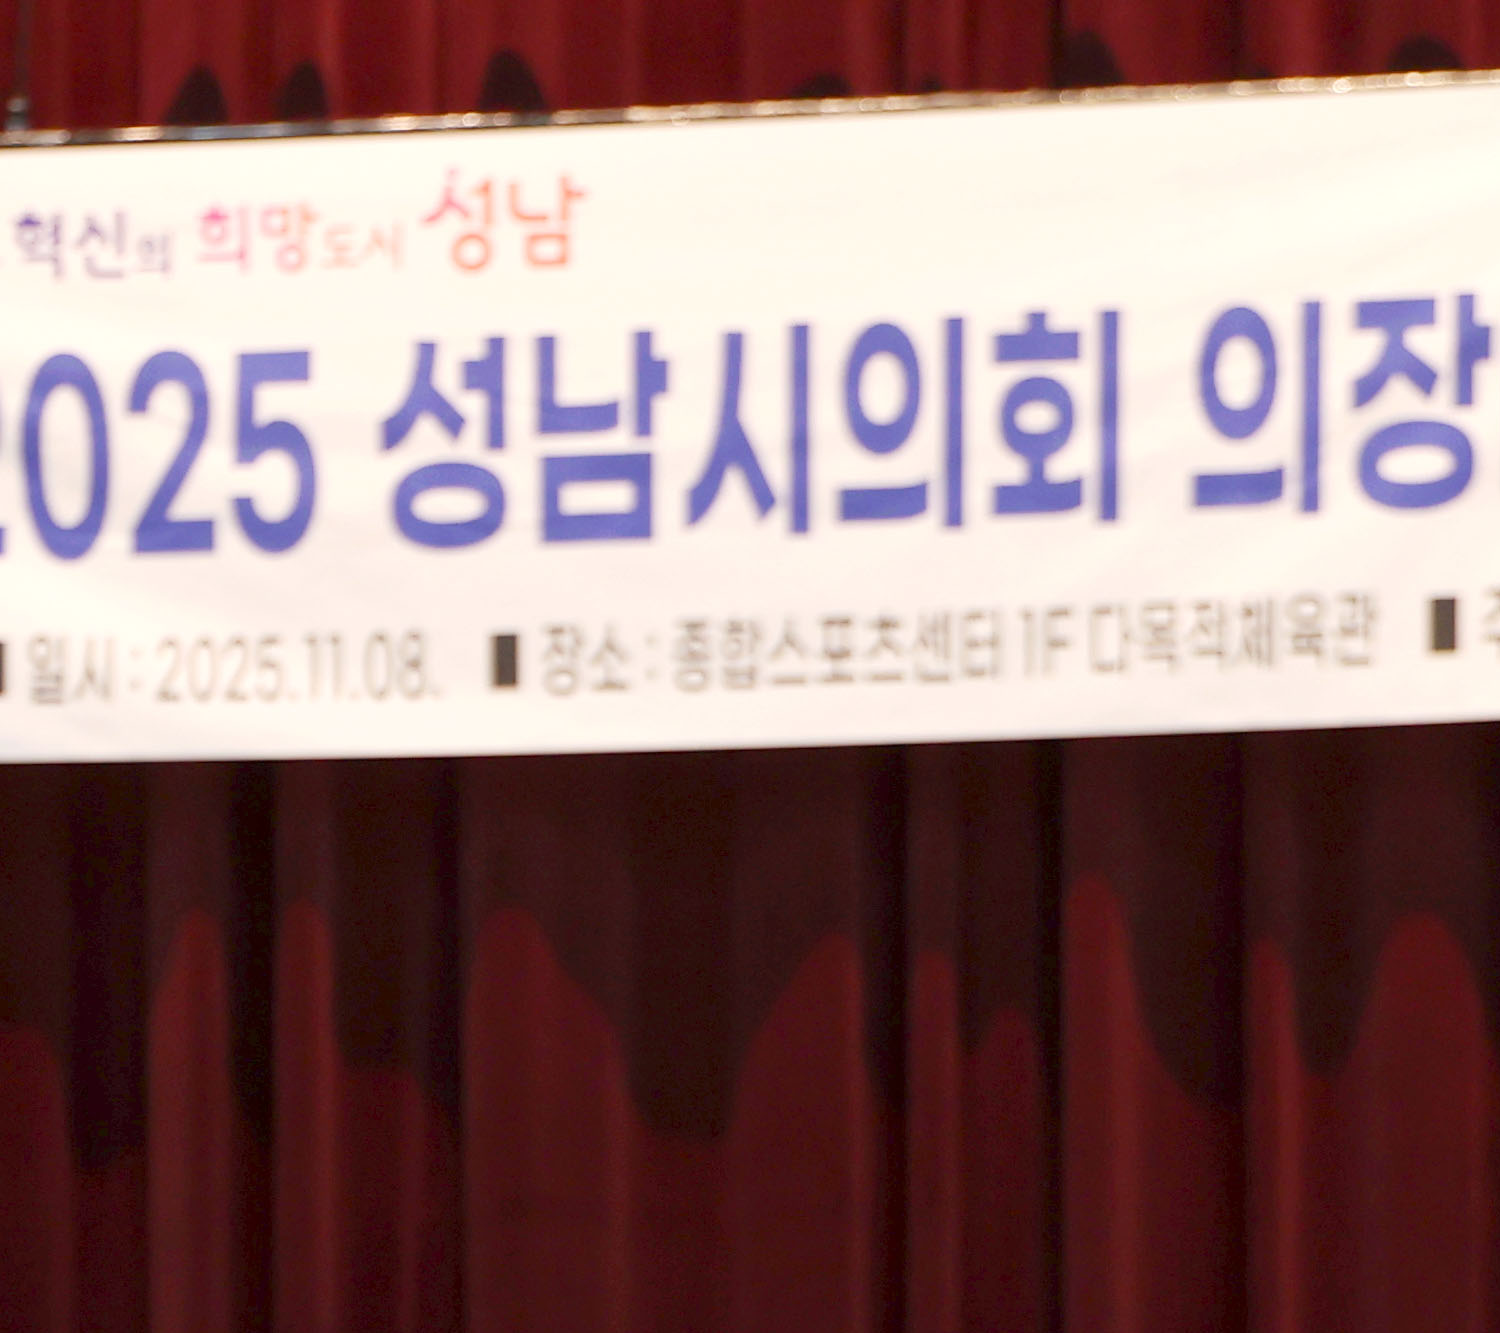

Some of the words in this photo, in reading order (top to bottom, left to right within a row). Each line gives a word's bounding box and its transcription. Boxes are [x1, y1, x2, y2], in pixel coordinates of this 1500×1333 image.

[12, 210, 172, 281] 혁신의
[195, 202, 403, 275] 희망도시
[420, 169, 587, 275] 성남
[379, 309, 1122, 552] 성남시의회
[155, 626, 441, 704] 2025.11.08.
